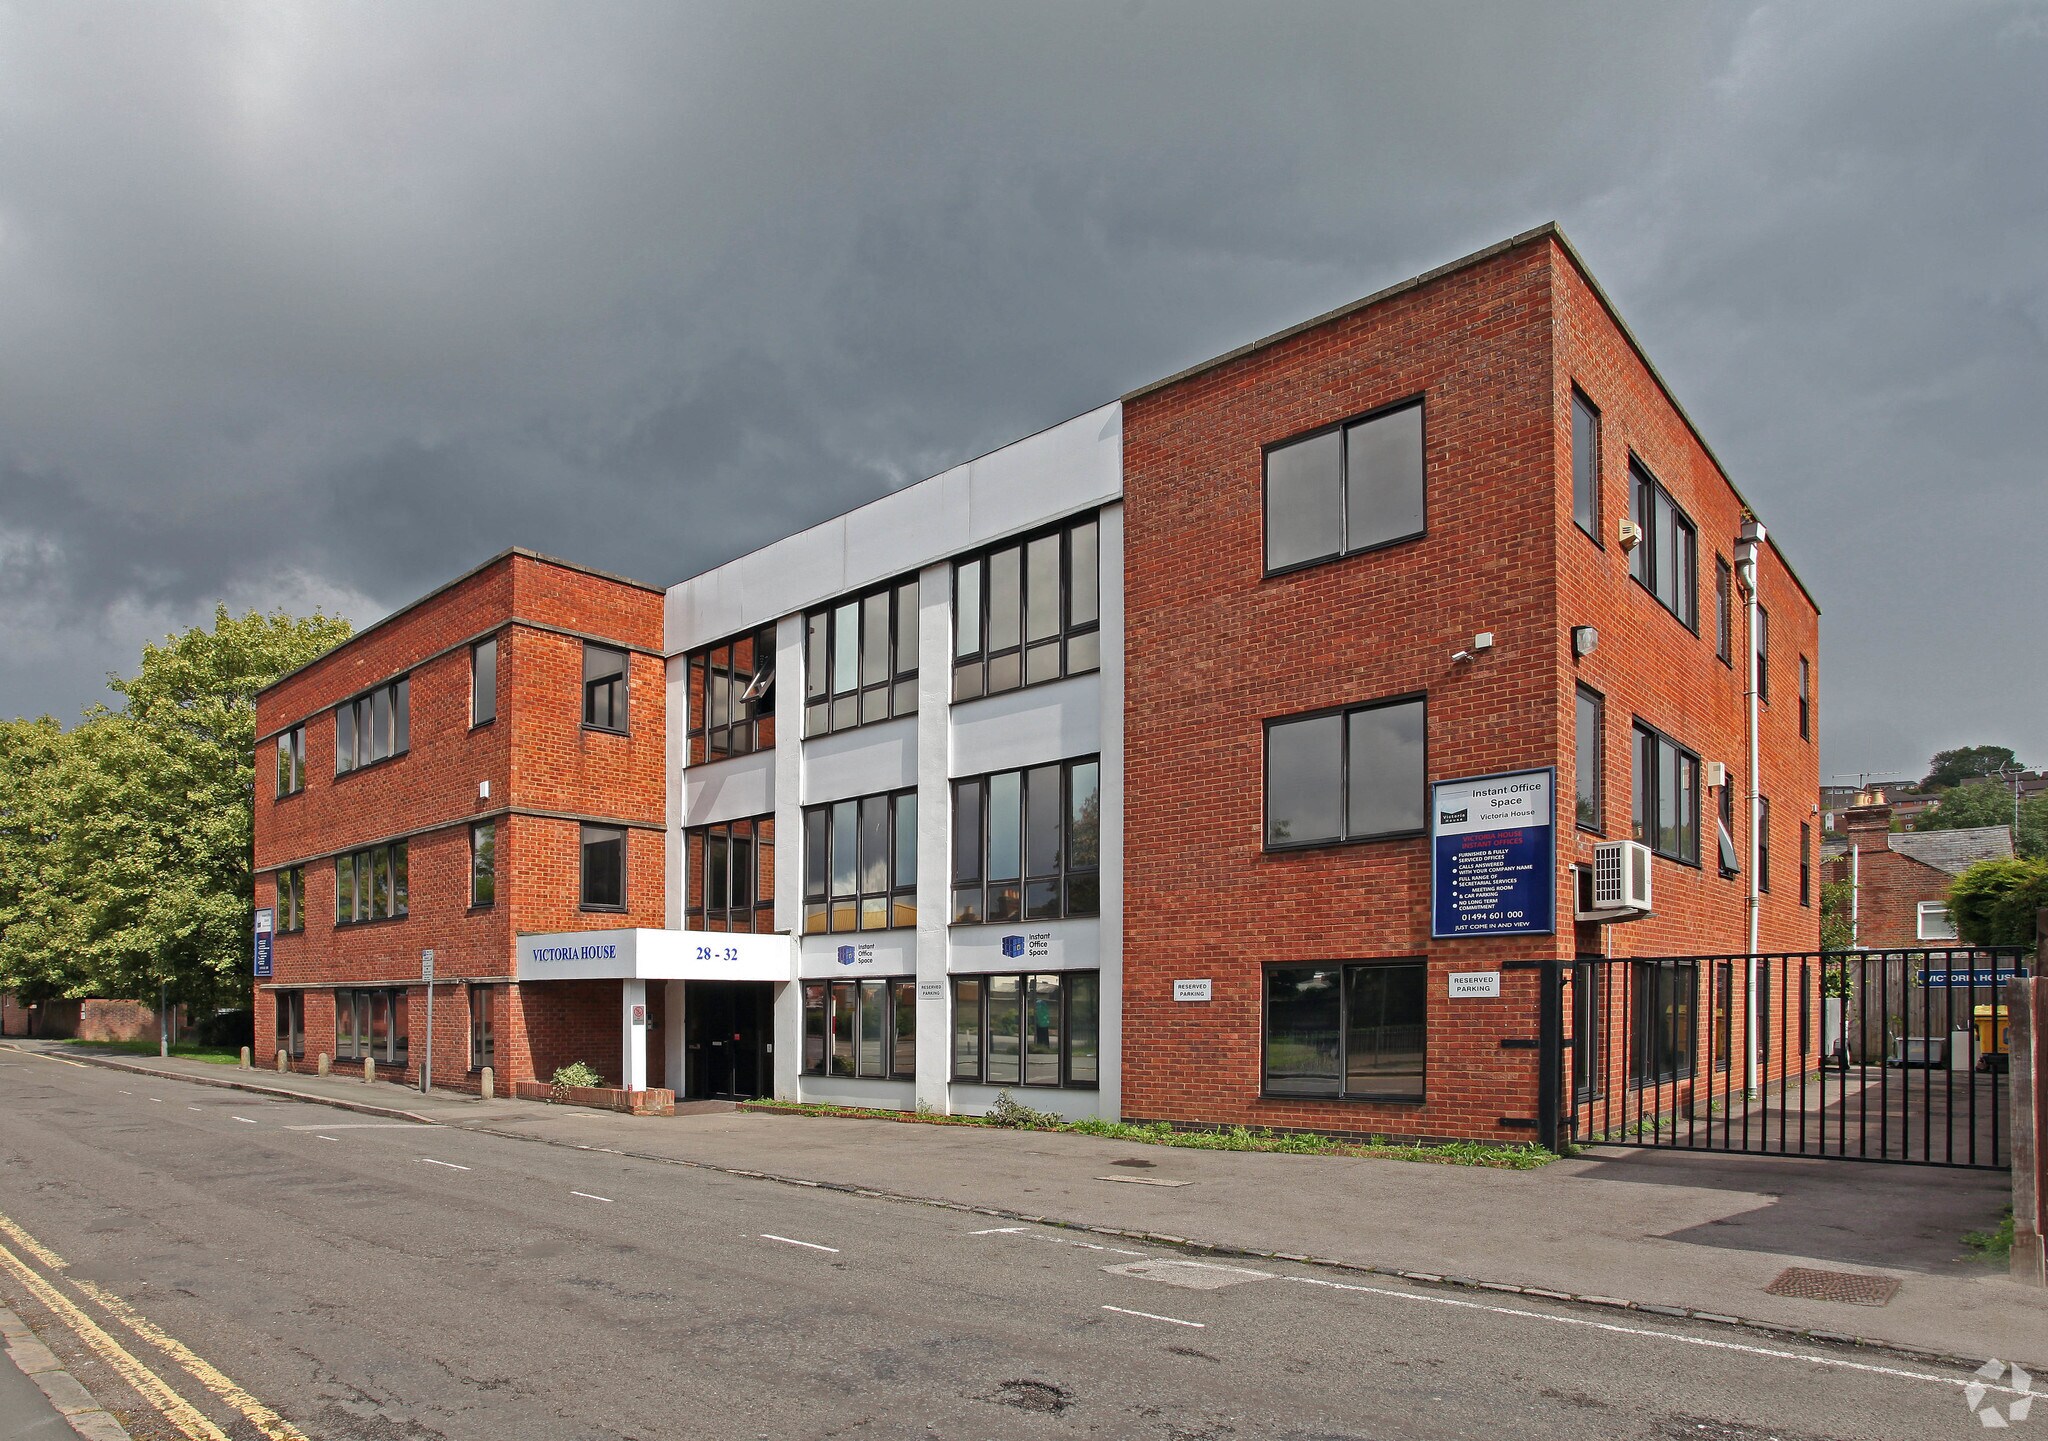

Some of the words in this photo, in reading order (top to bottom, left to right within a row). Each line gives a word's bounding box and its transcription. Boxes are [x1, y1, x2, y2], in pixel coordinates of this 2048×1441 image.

[1472, 786, 1507, 798] Instant
[1510, 783, 1541, 793] Office
[1490, 797, 1522, 808] Space
[1480, 812, 1508, 820] Victoria
[1463, 833, 1496, 842] VICTORIA
[1462, 840, 1492, 849] INSTANT
[1494, 838, 1523, 846] OFFICES
[533, 947, 579, 962] VICTORIA
[581, 945, 616, 959] HOUSE
[696, 946, 711, 960] 28
[724, 948, 737, 960] 32
